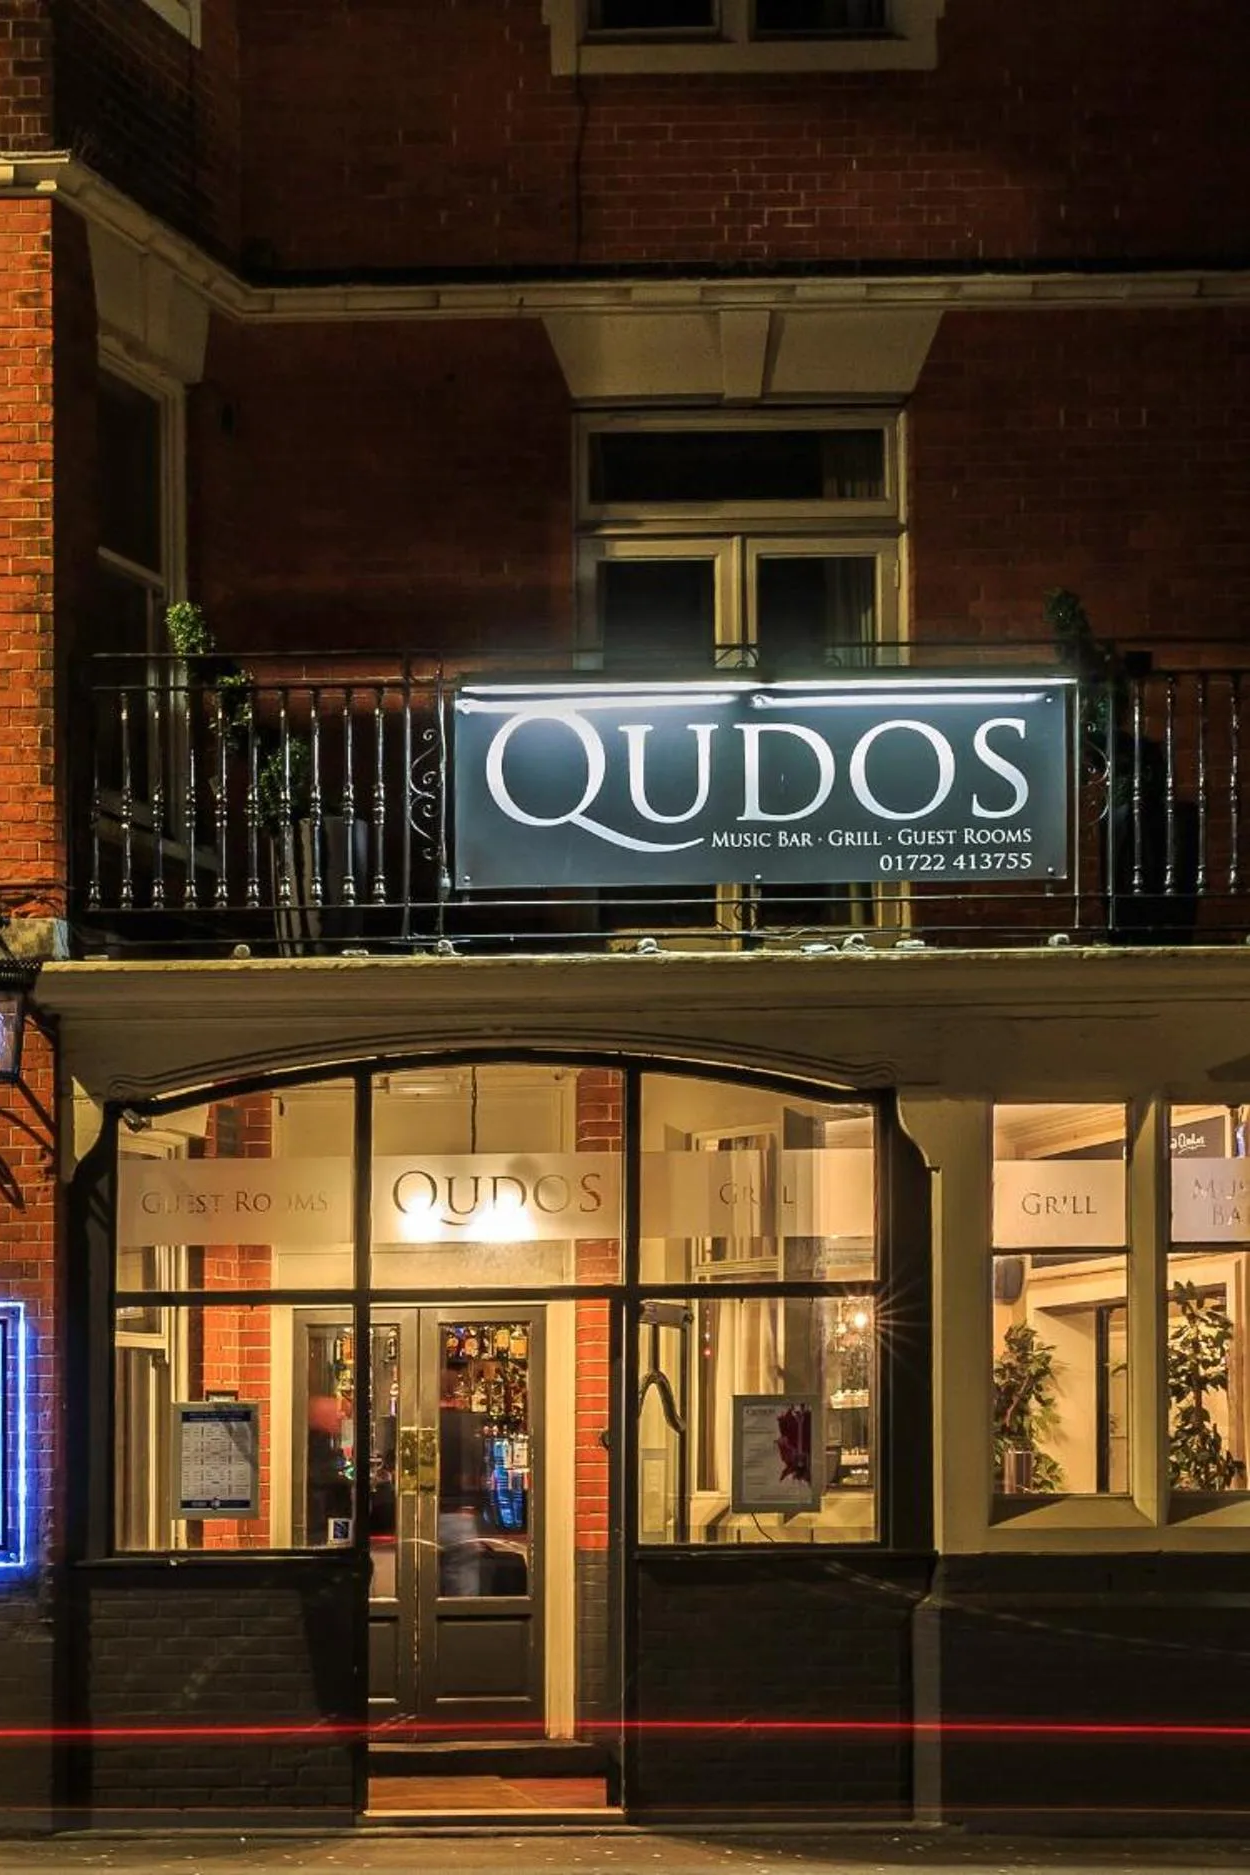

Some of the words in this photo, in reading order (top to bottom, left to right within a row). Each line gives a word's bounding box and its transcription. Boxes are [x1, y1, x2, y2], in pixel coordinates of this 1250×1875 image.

[485, 709, 1029, 852] QUDOS
[711, 832, 771, 847] MUSIC
[778, 832, 813, 847] BAR
[828, 830, 882, 846] GRILL
[897, 829, 957, 845] GUEST
[963, 828, 1032, 844] ROOMS
[879, 854, 945, 871] 01722
[952, 852, 1033, 870] 413755
[235, 1191, 328, 1213] ROMS
[392, 1170, 602, 1226] QUDOS
[719, 1182, 795, 1205] GRL
